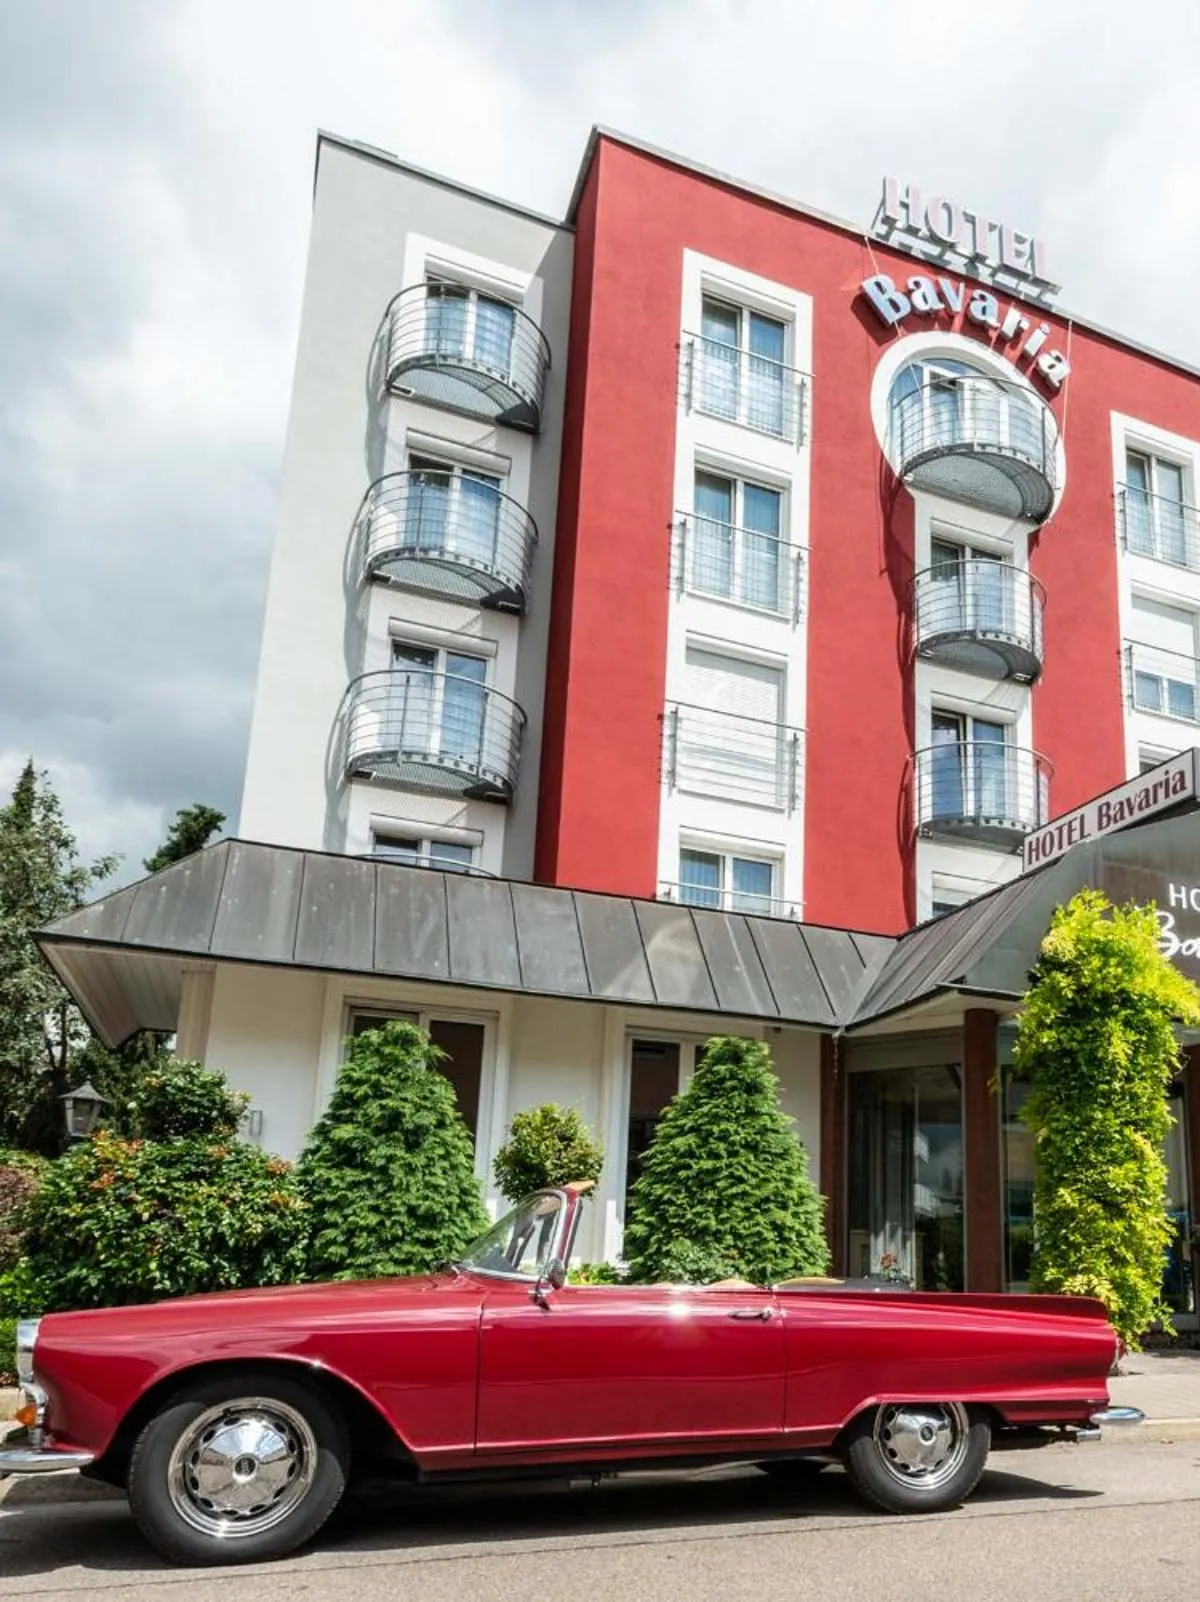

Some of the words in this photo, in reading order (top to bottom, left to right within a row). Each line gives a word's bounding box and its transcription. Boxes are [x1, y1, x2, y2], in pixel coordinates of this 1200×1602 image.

[881, 176, 1048, 281] HOTEL
[860, 273, 1072, 388] Bavaria
[1027, 812, 1091, 866] HOTEL
[1096, 768, 1189, 832] Bavaria
